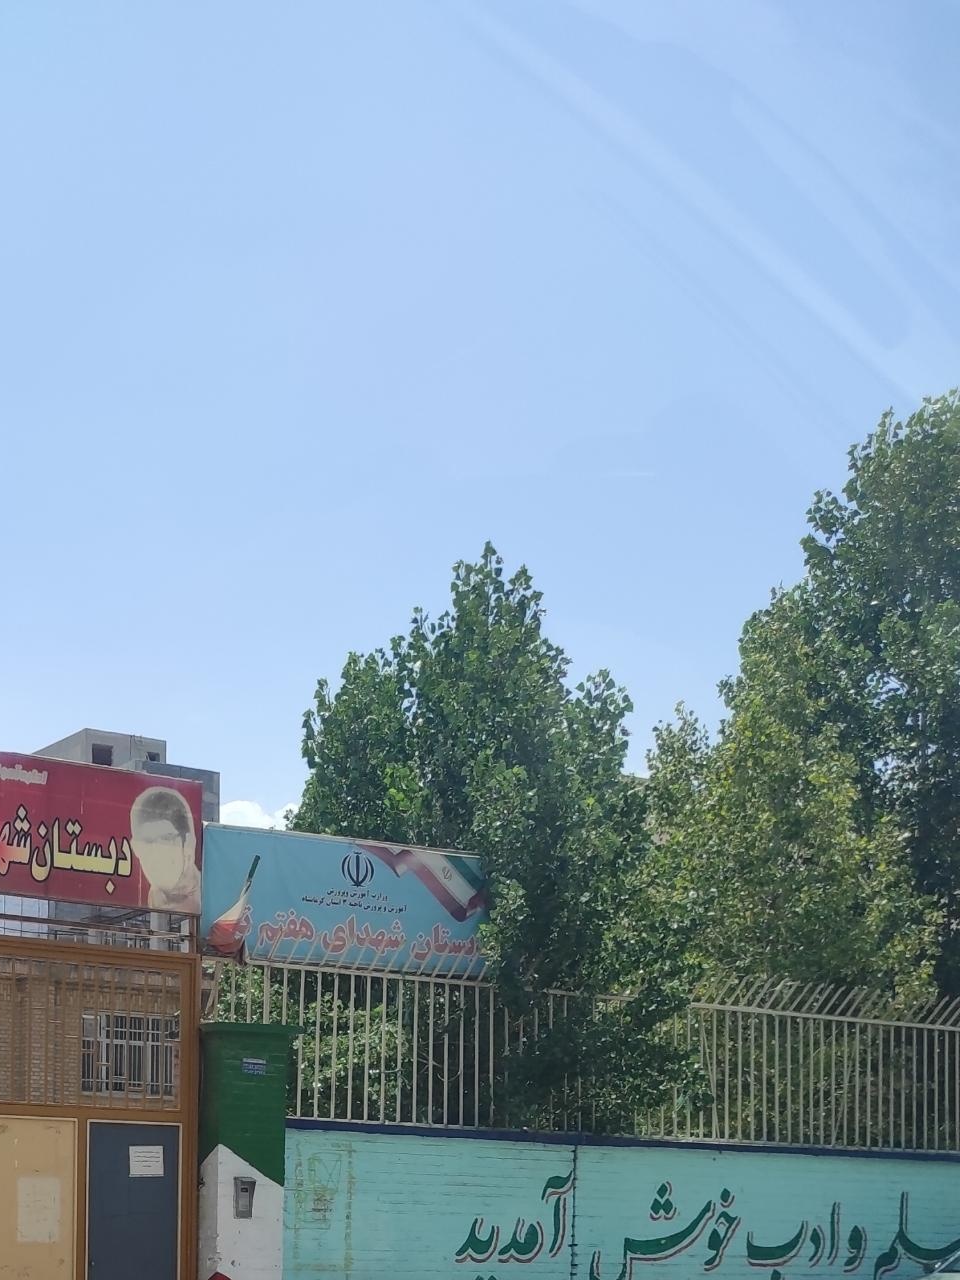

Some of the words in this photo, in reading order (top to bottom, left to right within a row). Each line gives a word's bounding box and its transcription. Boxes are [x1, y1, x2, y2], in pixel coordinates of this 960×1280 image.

[31, 817, 133, 895] دبستان
[257, 908, 317, 948] هفتم
[321, 914, 406, 956] شهدای
[843, 1225, 866, 1272] و
